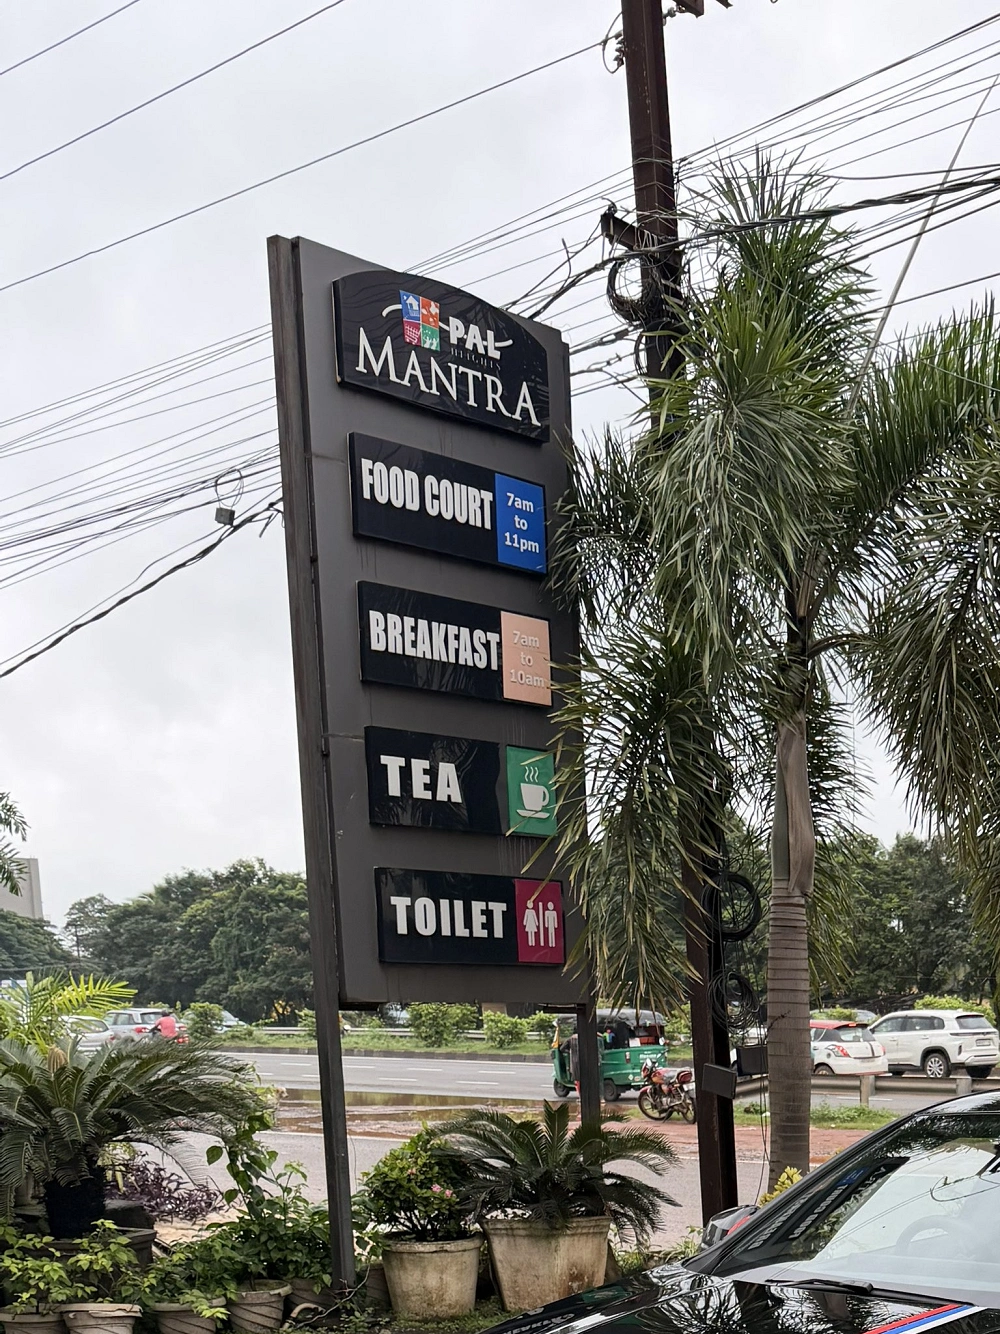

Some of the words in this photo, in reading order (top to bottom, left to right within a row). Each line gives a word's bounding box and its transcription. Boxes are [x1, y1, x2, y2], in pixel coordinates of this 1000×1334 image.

[449, 316, 501, 360] PAL
[355, 327, 541, 427] MANTRA
[361, 458, 419, 512] FOOD
[424, 475, 493, 530] COURT
[506, 492, 534, 513] 7am
[514, 514, 528, 530] to
[504, 532, 540, 554] 11pm
[368, 610, 500, 671] BREAKFAST
[513, 630, 540, 648] 7am
[520, 652, 533, 667] to
[510, 669, 545, 688] 10am
[380, 755, 463, 803] TEA
[390, 896, 507, 938] TOILET
